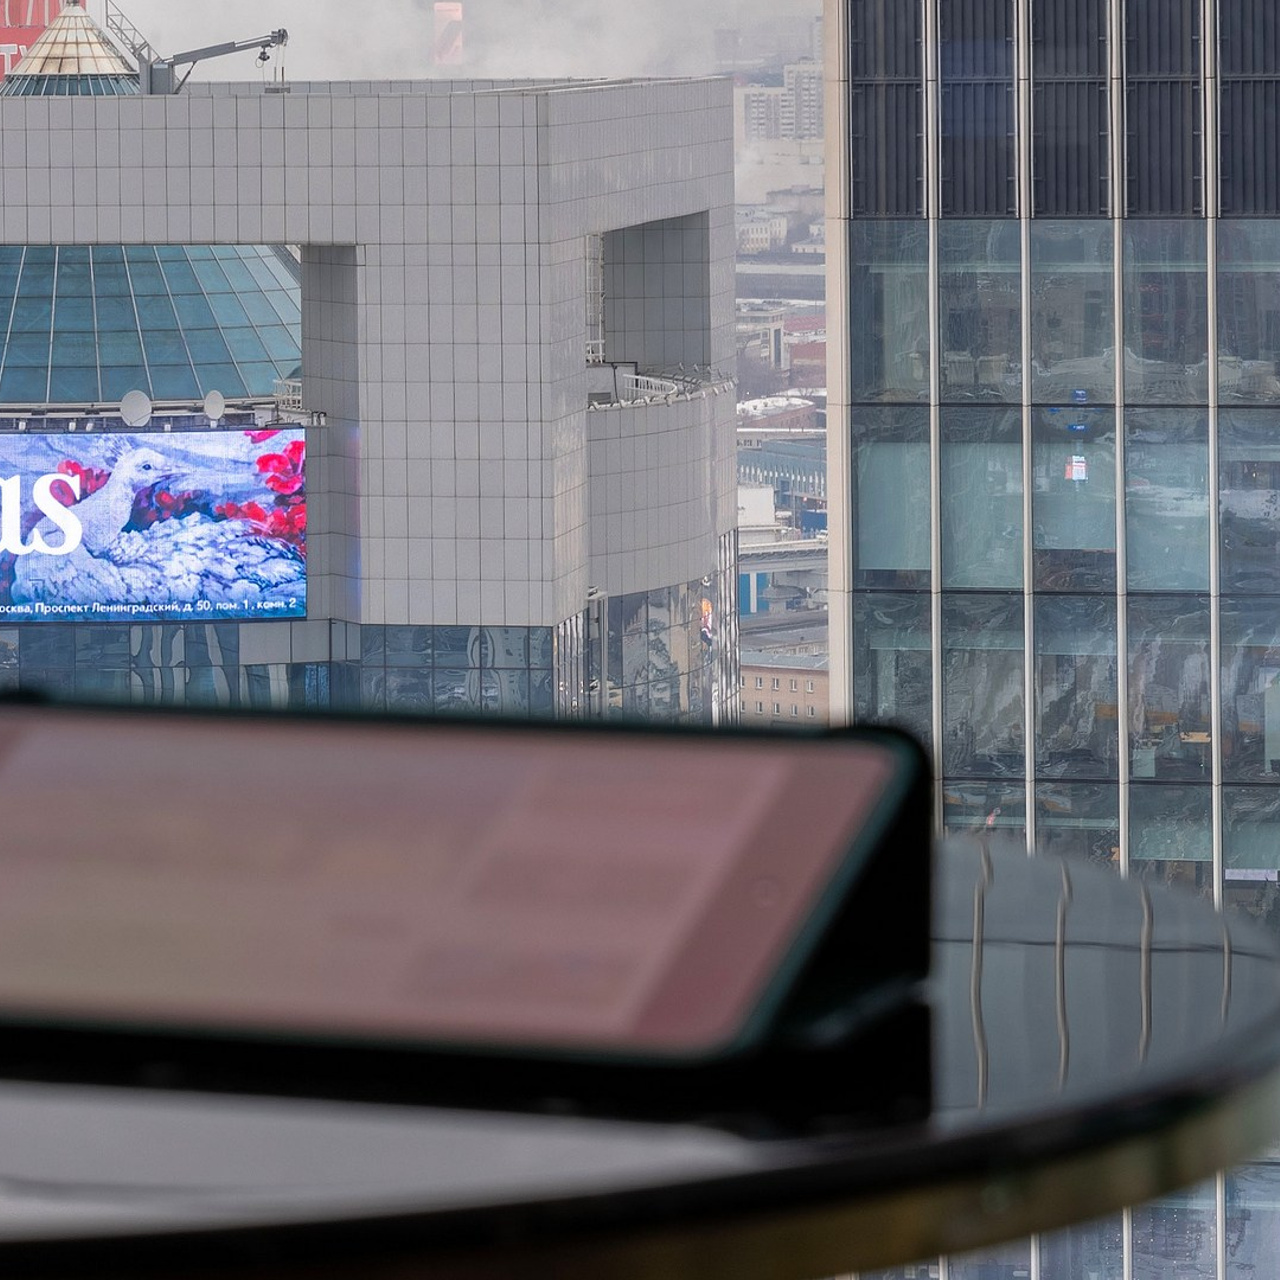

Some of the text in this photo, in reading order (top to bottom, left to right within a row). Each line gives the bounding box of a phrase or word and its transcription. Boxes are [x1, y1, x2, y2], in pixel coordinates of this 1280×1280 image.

[35, 602, 89, 615] Проспект
[92, 601, 181, 614] Ленинградский,
[197, 600, 213, 611] 50,
[289, 597, 297, 608] 2
